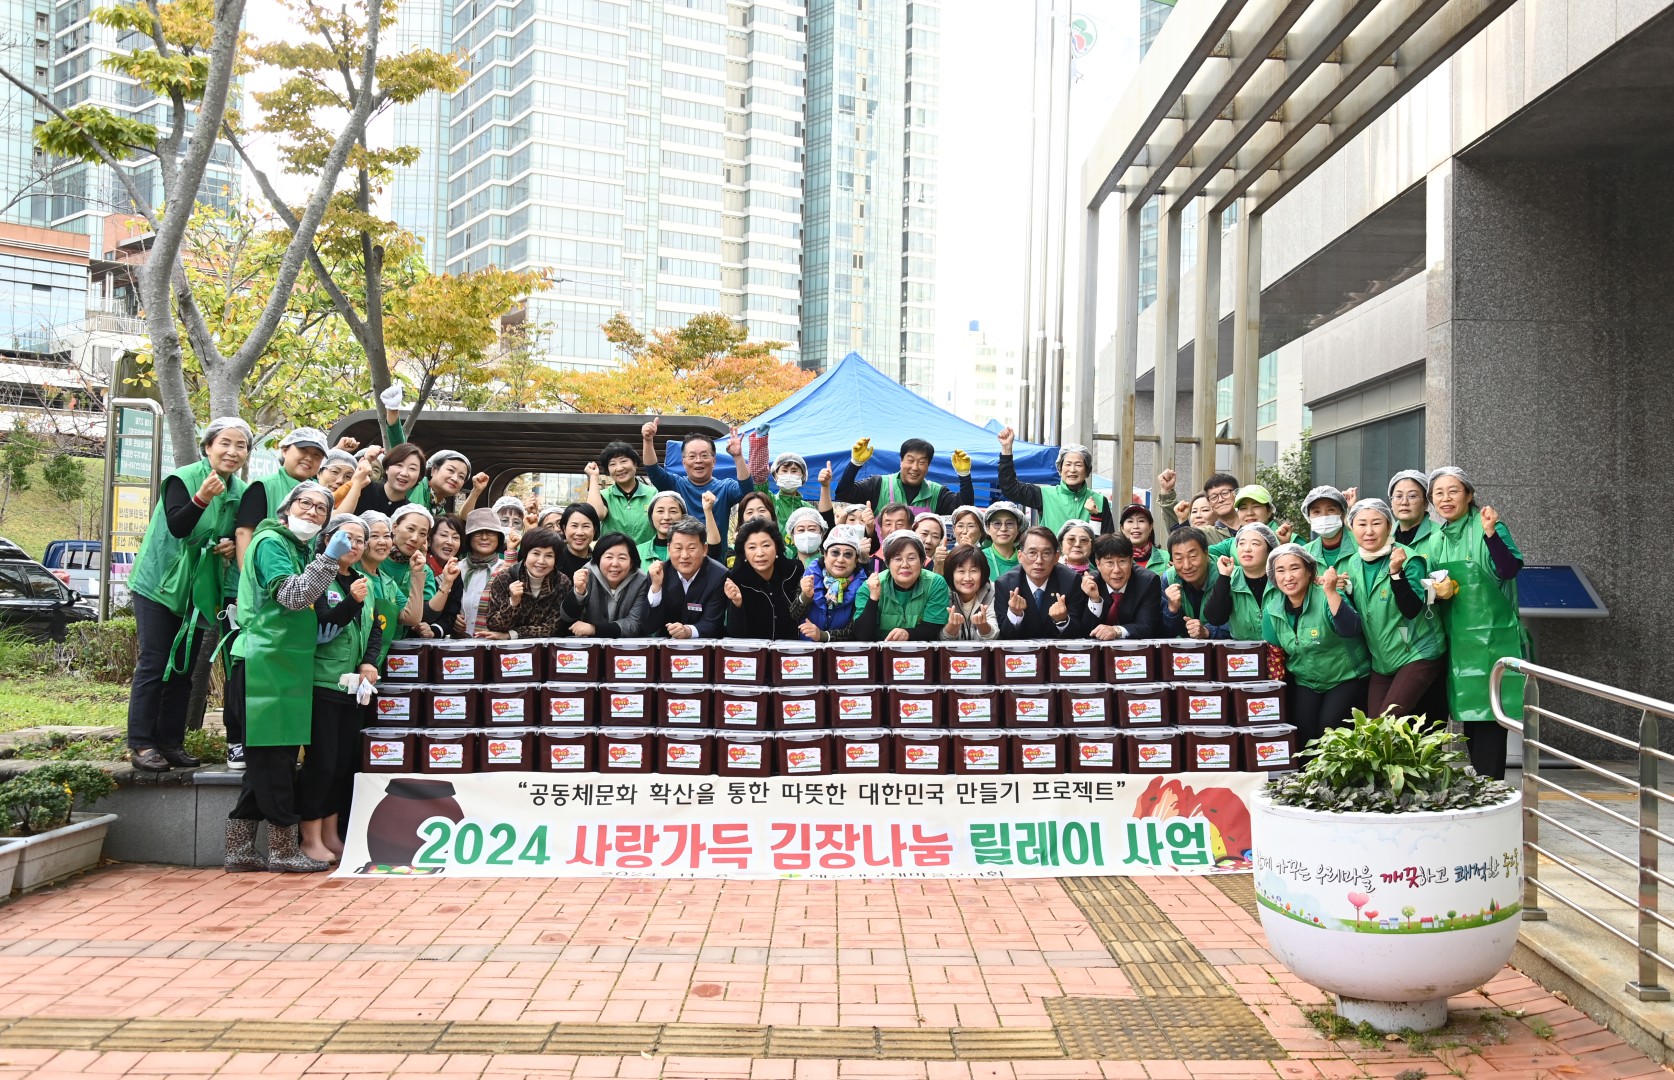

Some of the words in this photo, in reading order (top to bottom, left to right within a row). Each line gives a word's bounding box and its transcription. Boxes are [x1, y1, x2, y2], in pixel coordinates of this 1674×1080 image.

[649, 782, 715, 806] 확산을
[727, 781, 770, 805] 통한
[782, 782, 847, 806] 따뜻한
[859, 782, 945, 806] 대한민국
[956, 781, 1020, 805] 만들기
[1032, 780, 1126, 804] 프로젝트”
[419, 822, 551, 866] 2024
[566, 823, 753, 870] 사랑가득
[770, 822, 953, 870] 김장나눔
[970, 820, 1106, 867] 릴레이
[1123, 819, 1212, 867] 사업
[1275, 858, 1312, 882] 가꾸는
[1379, 865, 1450, 889] 깨끗하고
[1453, 855, 1500, 884] 쾌적한
